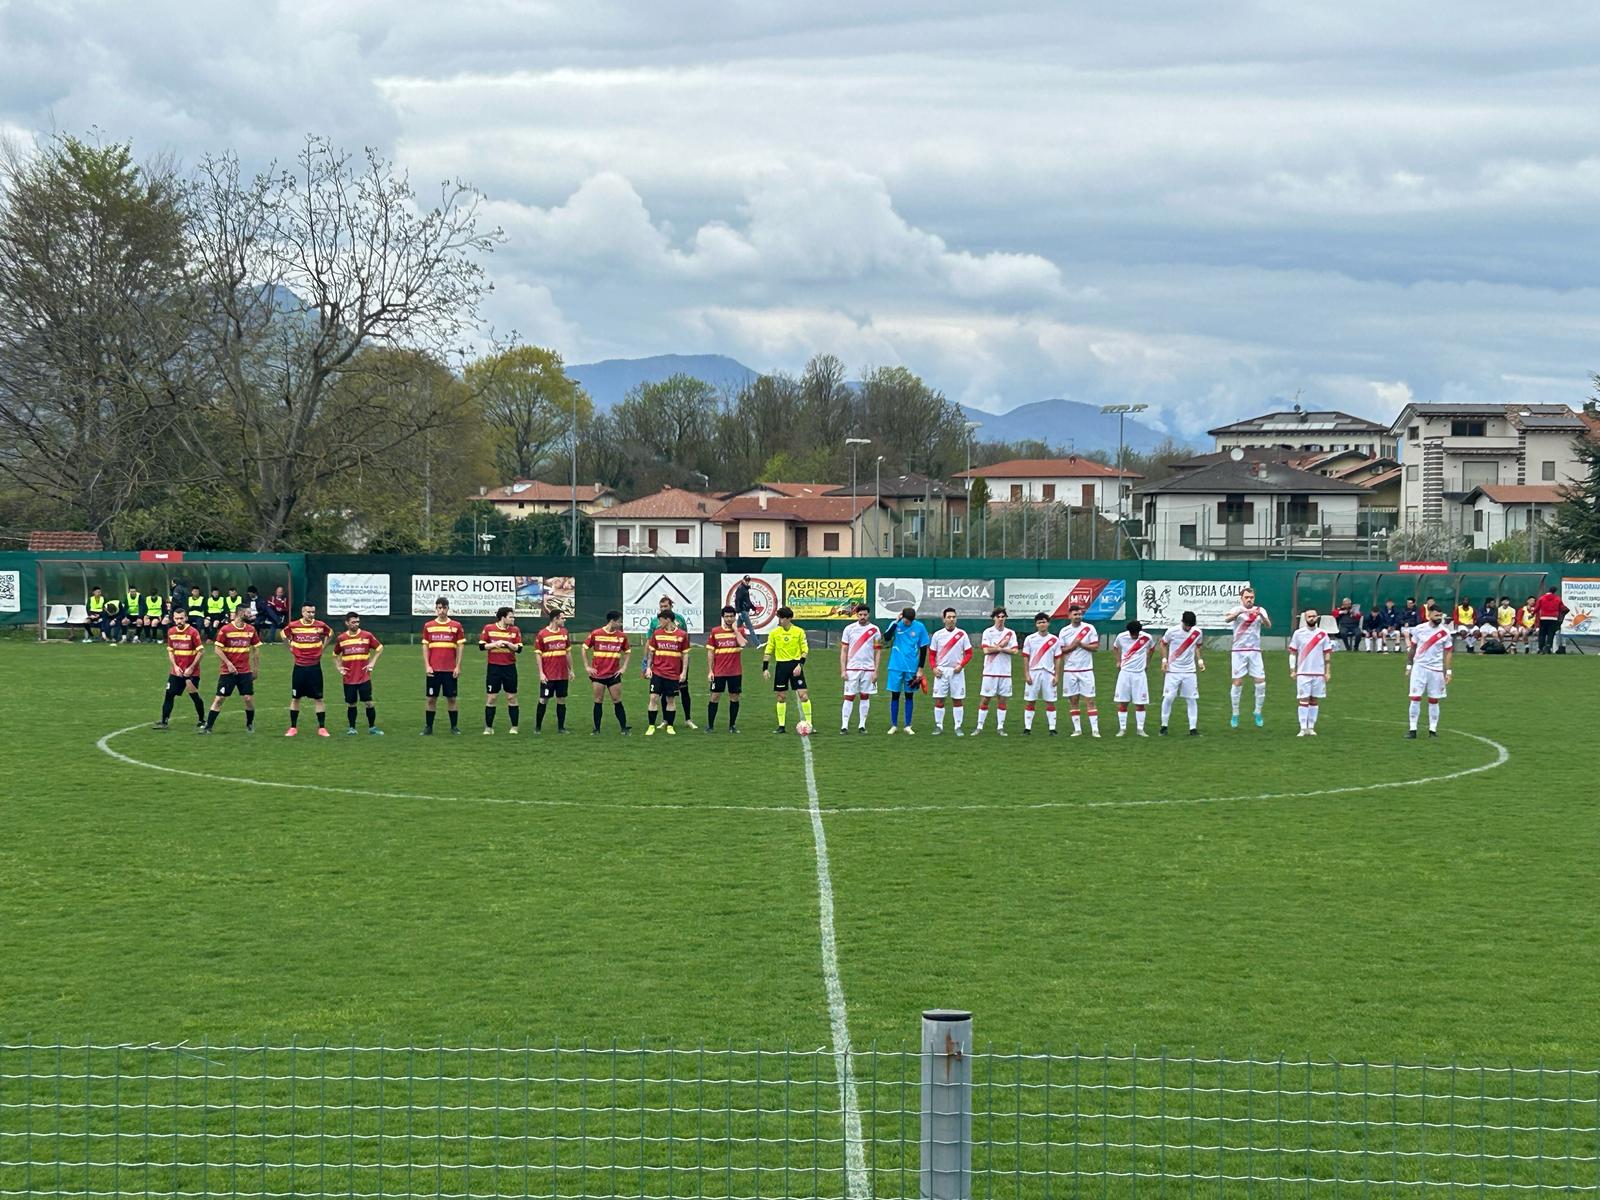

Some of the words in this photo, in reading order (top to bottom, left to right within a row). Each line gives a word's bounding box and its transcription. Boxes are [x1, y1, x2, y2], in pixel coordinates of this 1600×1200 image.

[415, 579, 468, 592] IMPERO
[473, 580, 514, 593] HOTEL
[788, 580, 853, 590] AGRICOLA
[1178, 584, 1217, 597] OSTERIA
[788, 589, 849, 598] ARCISATE
[927, 585, 990, 598] FELMOKA
[1009, 592, 1038, 600] materiali
[1039, 592, 1054, 600] edili
